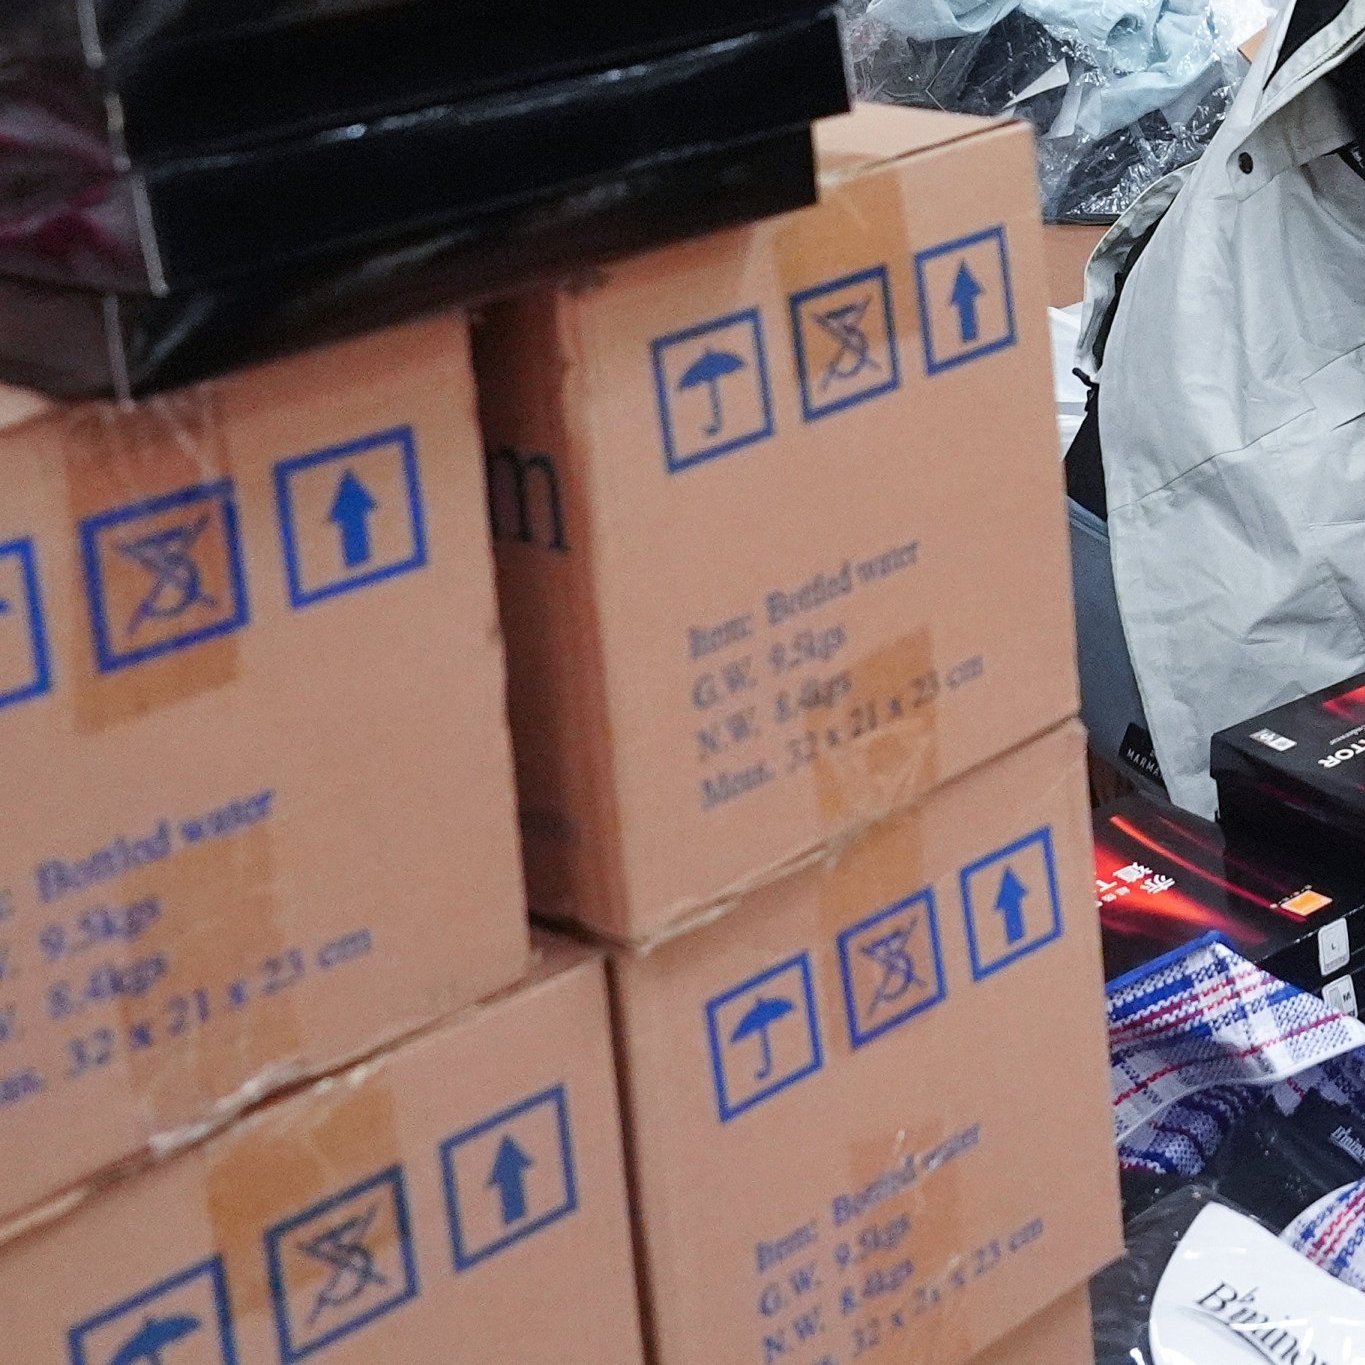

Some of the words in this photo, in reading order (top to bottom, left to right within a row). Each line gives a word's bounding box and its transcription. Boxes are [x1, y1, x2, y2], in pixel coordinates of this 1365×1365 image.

[855, 540, 920, 582] water
[181, 788, 277, 844] water
[315, 928, 374, 970] cm
